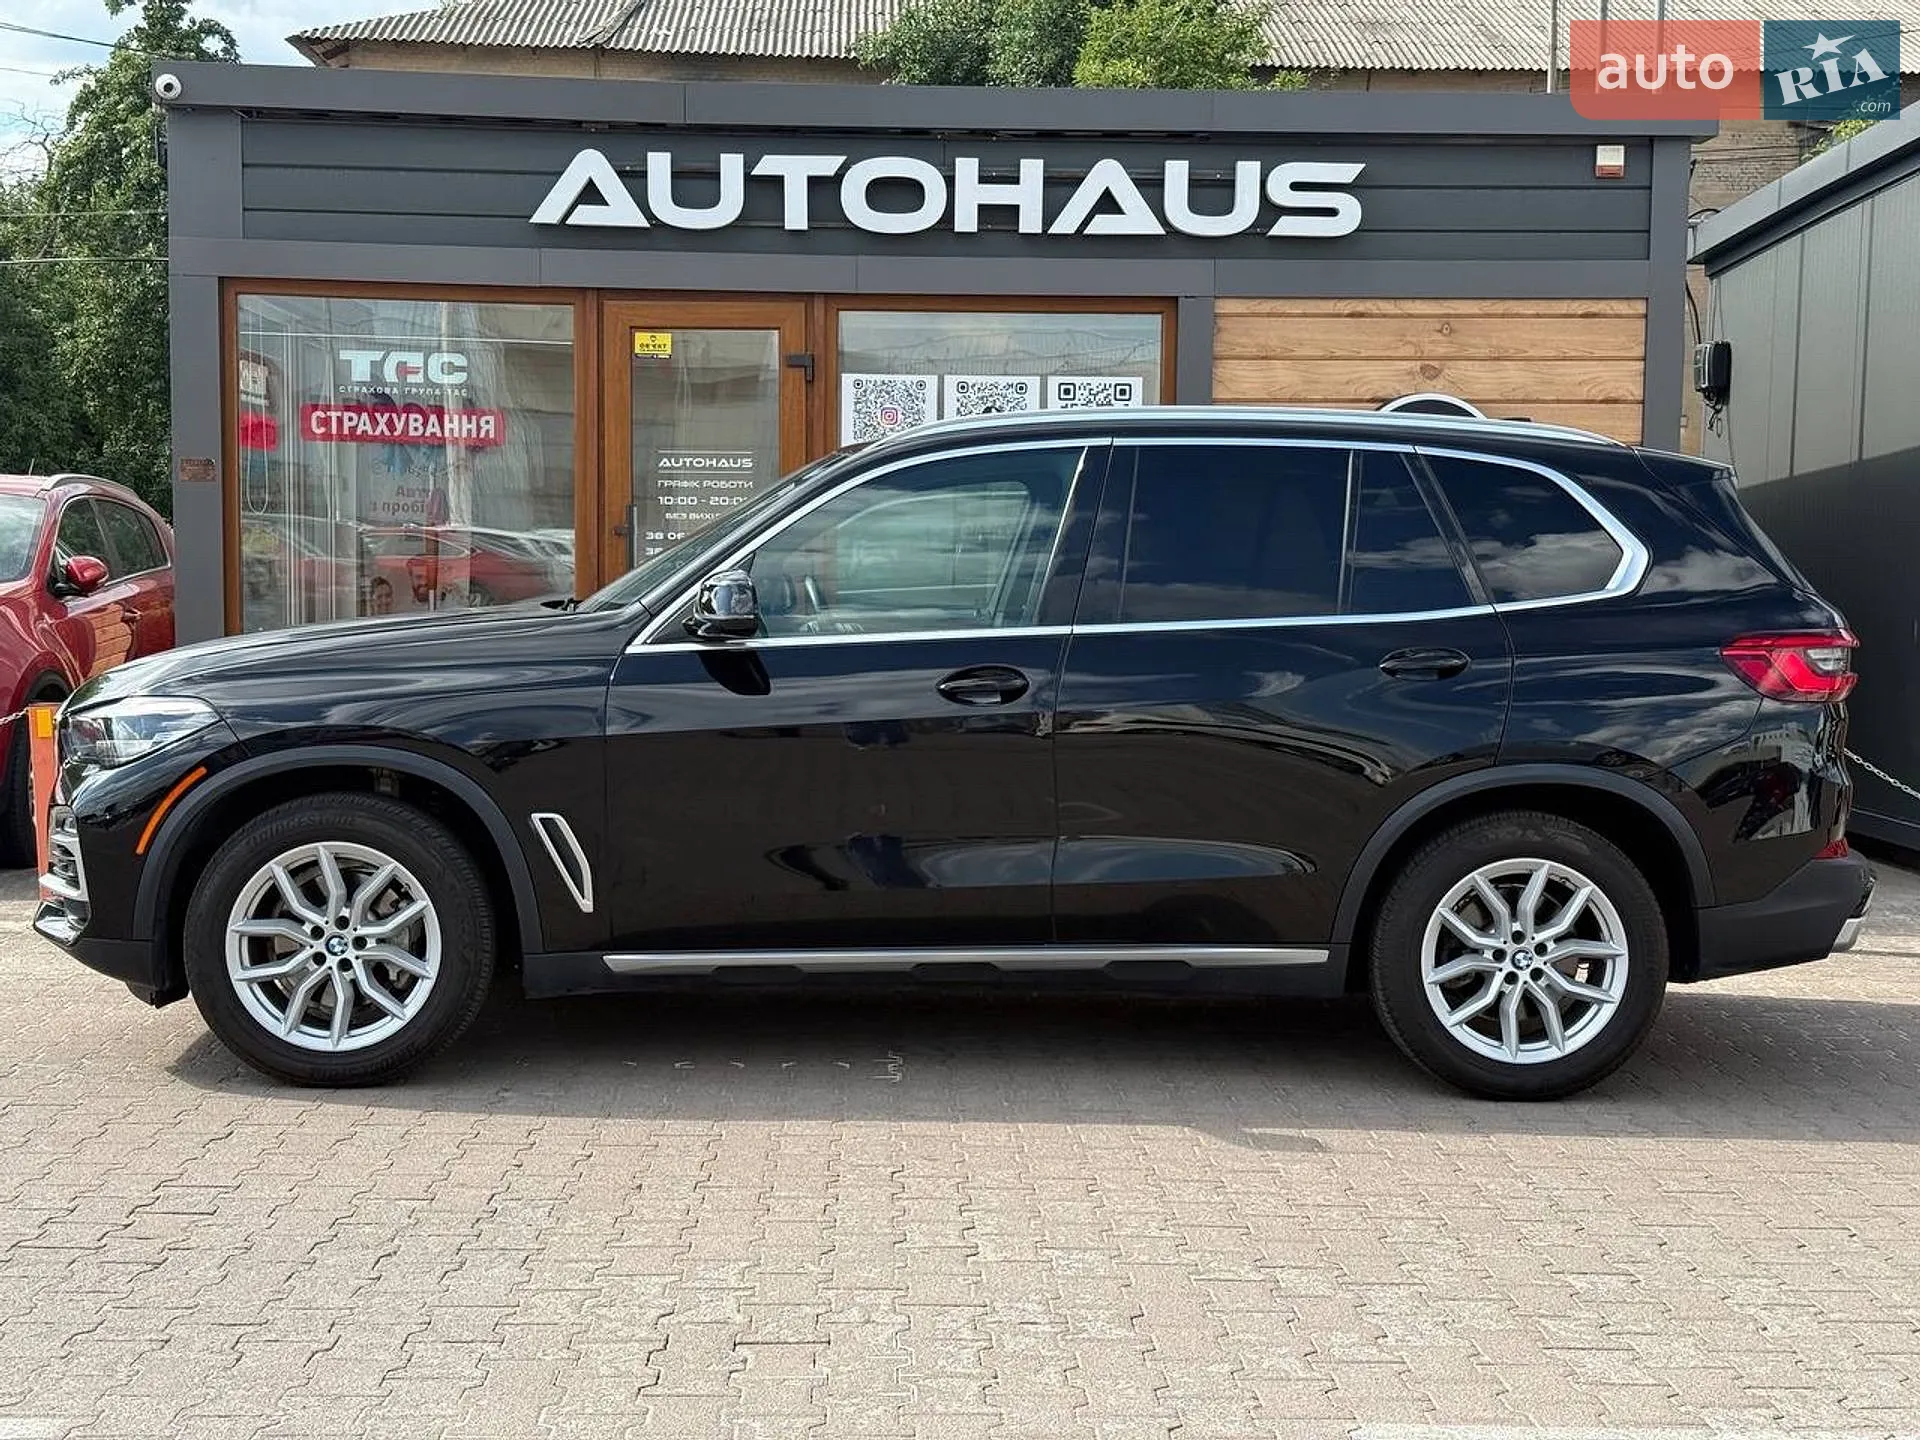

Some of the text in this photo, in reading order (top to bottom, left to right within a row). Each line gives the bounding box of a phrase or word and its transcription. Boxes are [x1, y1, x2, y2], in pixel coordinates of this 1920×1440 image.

[529, 148, 1366, 237] AUTOHAUS
[310, 410, 495, 439] СТРАХУВАННЯ
[658, 458, 753, 468] AUTOHAUS
[703, 480, 753, 489] РОБОТИ
[657, 496, 698, 506] 10:00
